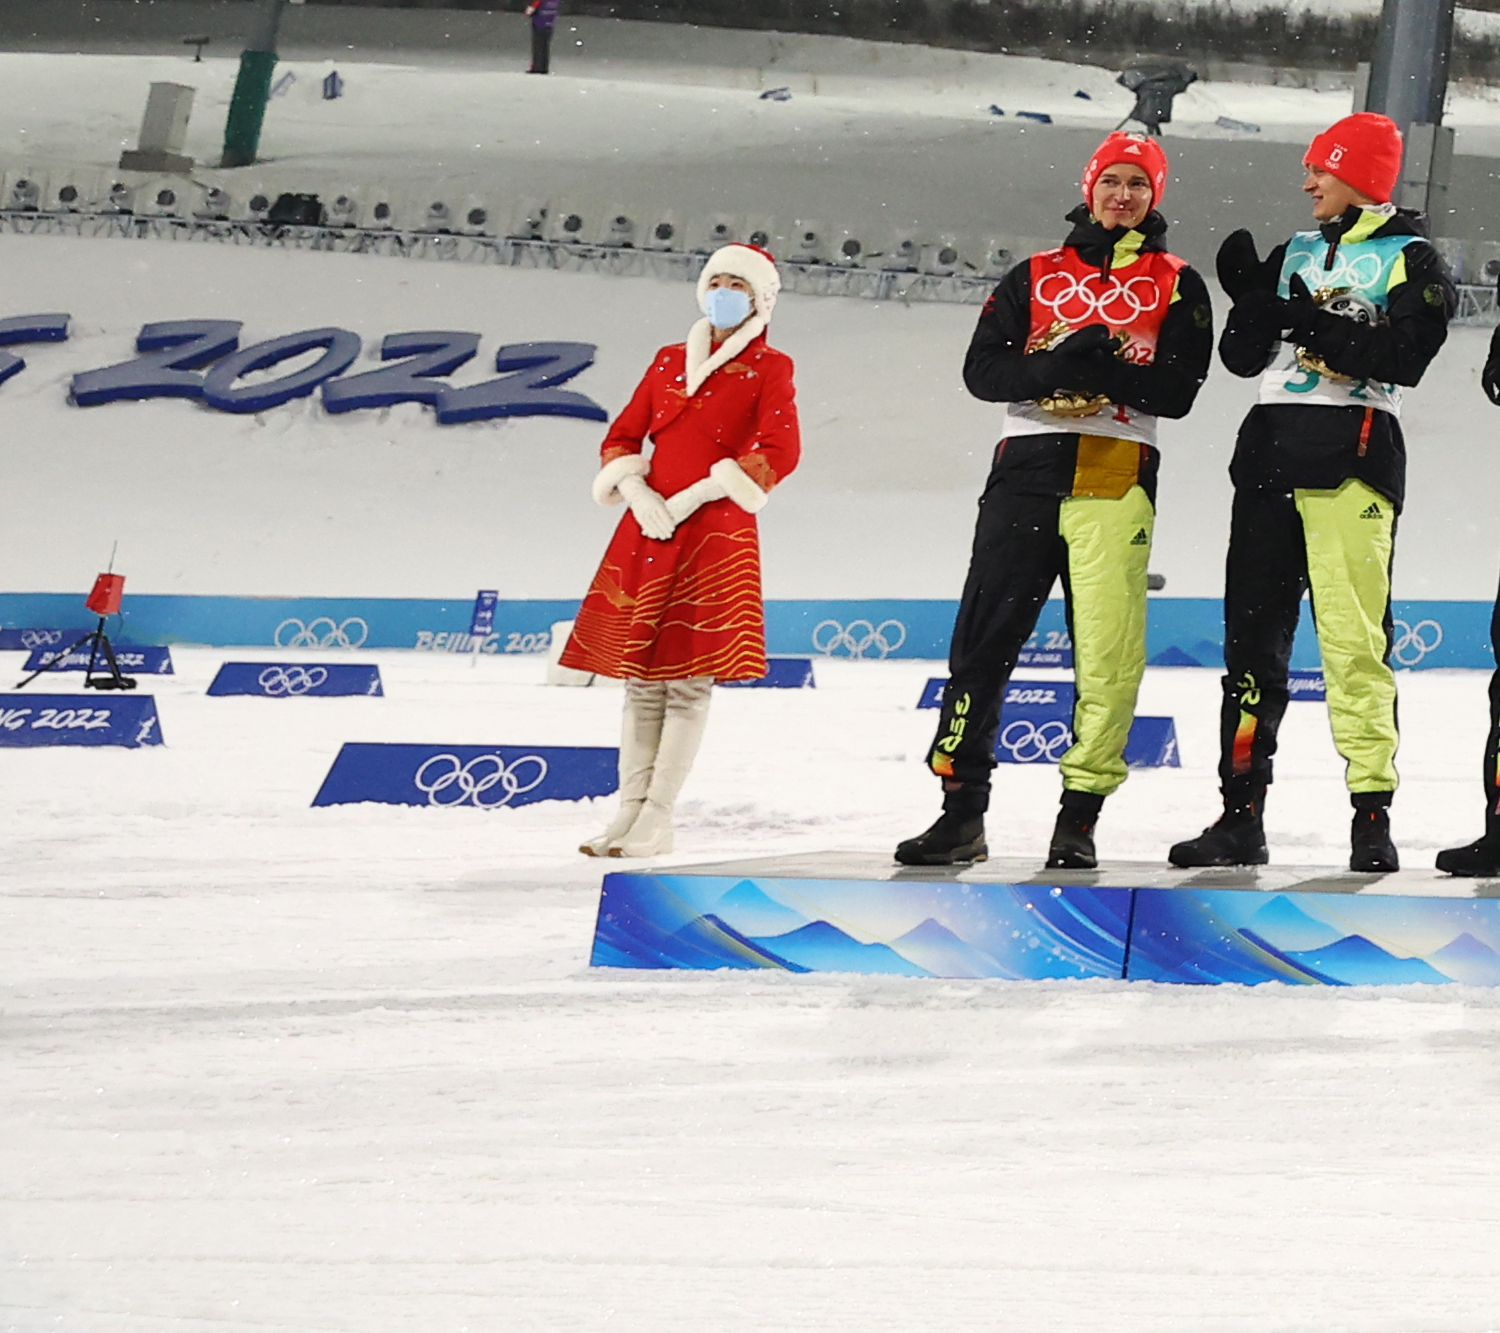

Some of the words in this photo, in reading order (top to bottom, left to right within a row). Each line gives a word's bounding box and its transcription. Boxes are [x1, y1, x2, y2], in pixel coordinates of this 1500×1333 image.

[1329, 148, 1344, 163] D
[70, 319, 608, 425] 2022
[1004, 688, 1057, 704] 2022
[31, 708, 112, 730] 2022
[938, 692, 971, 752] GER
